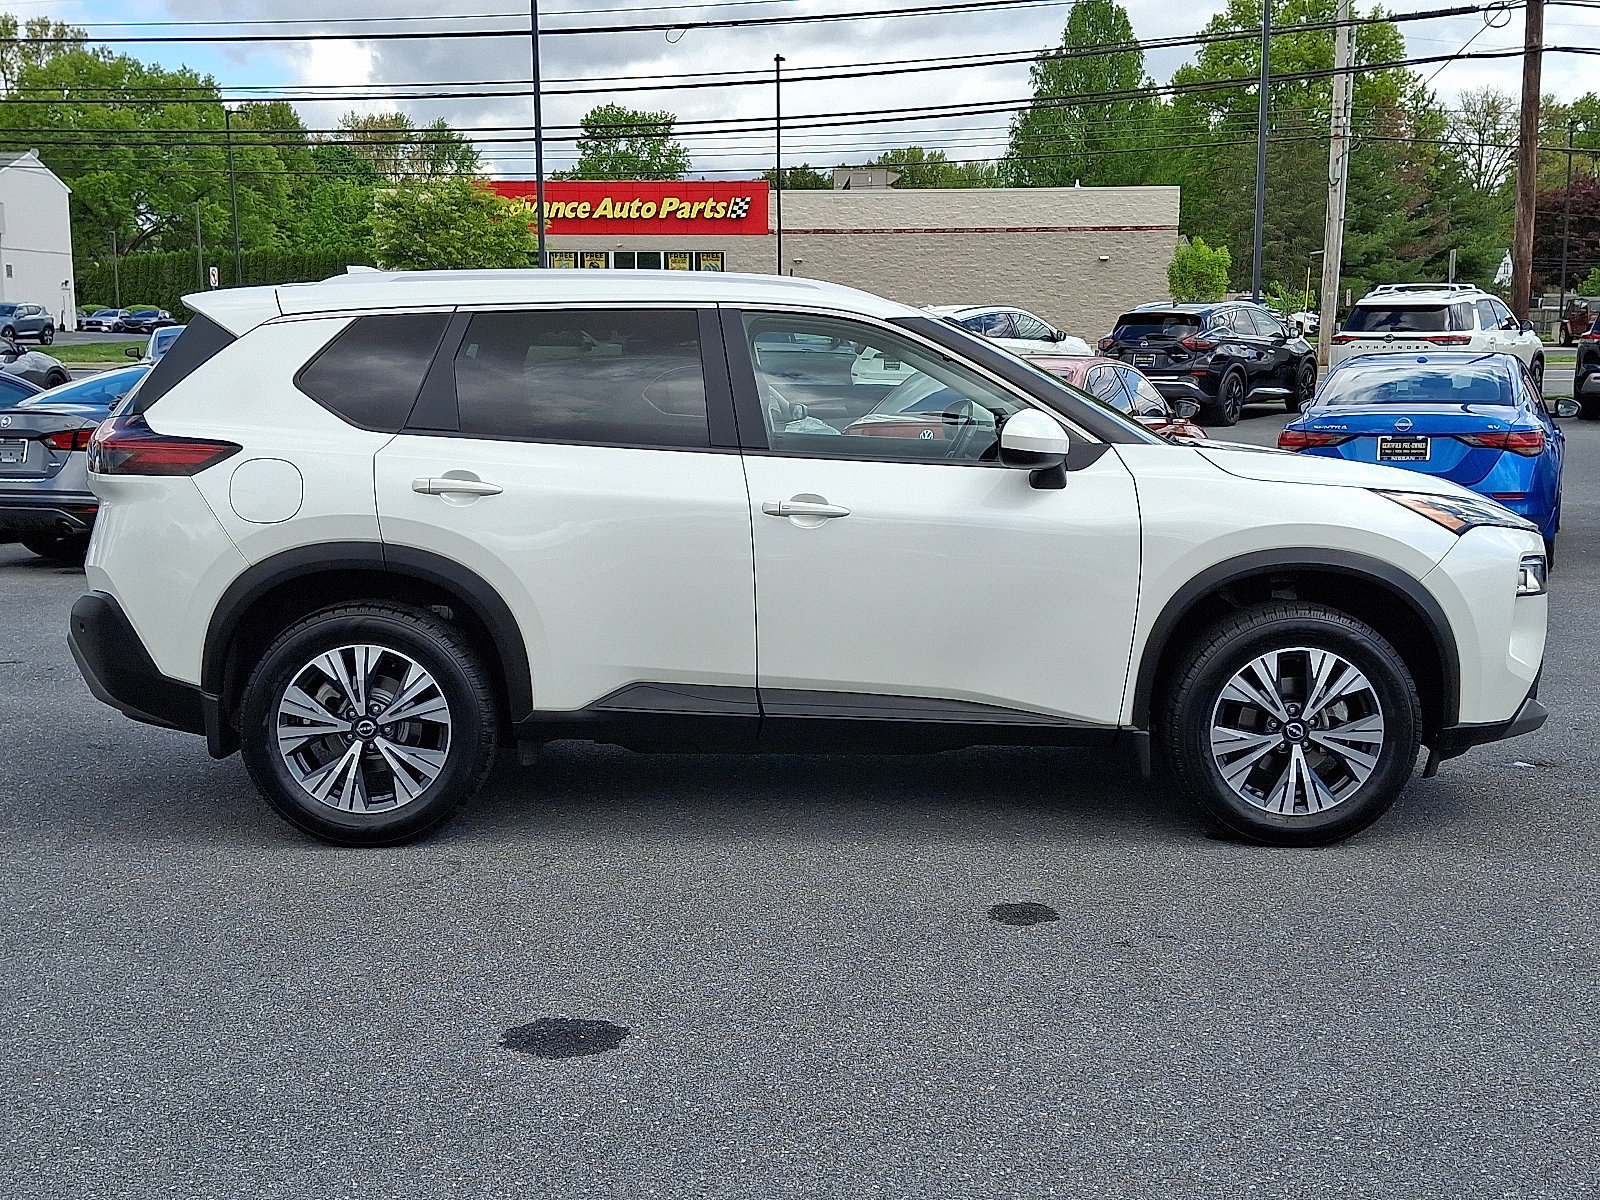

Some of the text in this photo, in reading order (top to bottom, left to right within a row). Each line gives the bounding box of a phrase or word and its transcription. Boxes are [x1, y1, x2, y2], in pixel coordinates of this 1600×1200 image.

[497, 197, 729, 219] dvnce Auto Parts
